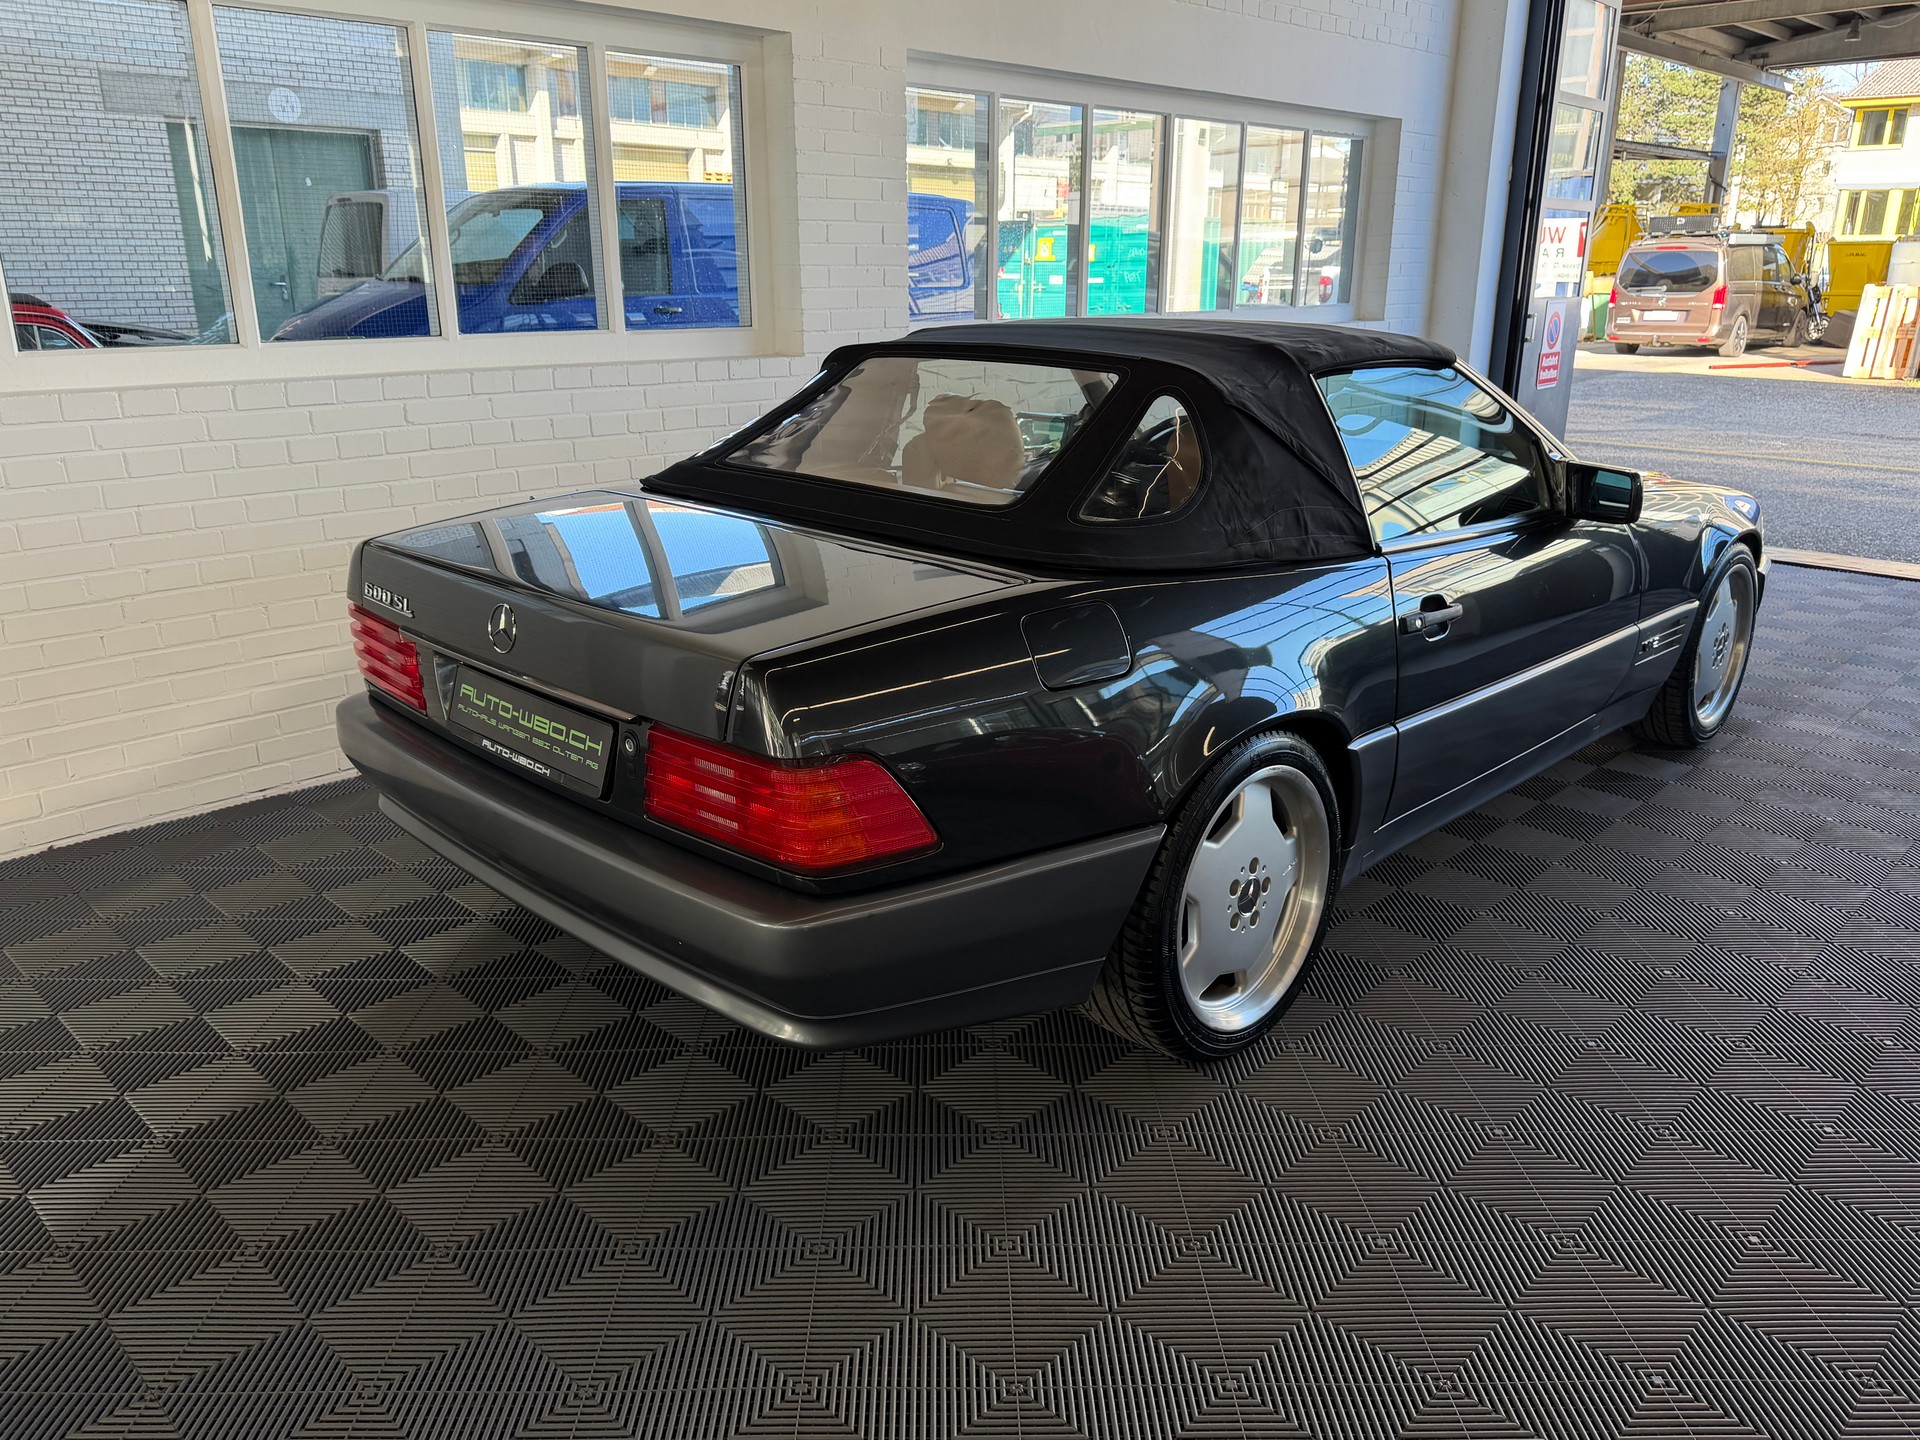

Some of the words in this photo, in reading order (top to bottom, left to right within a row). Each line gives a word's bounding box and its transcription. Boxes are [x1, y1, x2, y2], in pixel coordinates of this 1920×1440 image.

[364, 581, 391, 605] 600
[392, 594, 412, 613] SL
[458, 703, 497, 726] AUTOHAUS
[498, 721, 531, 741] WANGEN
[532, 737, 551, 750] BEI
[552, 745, 584, 764] OLTEN
[585, 759, 599, 771] AG
[460, 683, 602, 756] AUTO-WBO.CH
